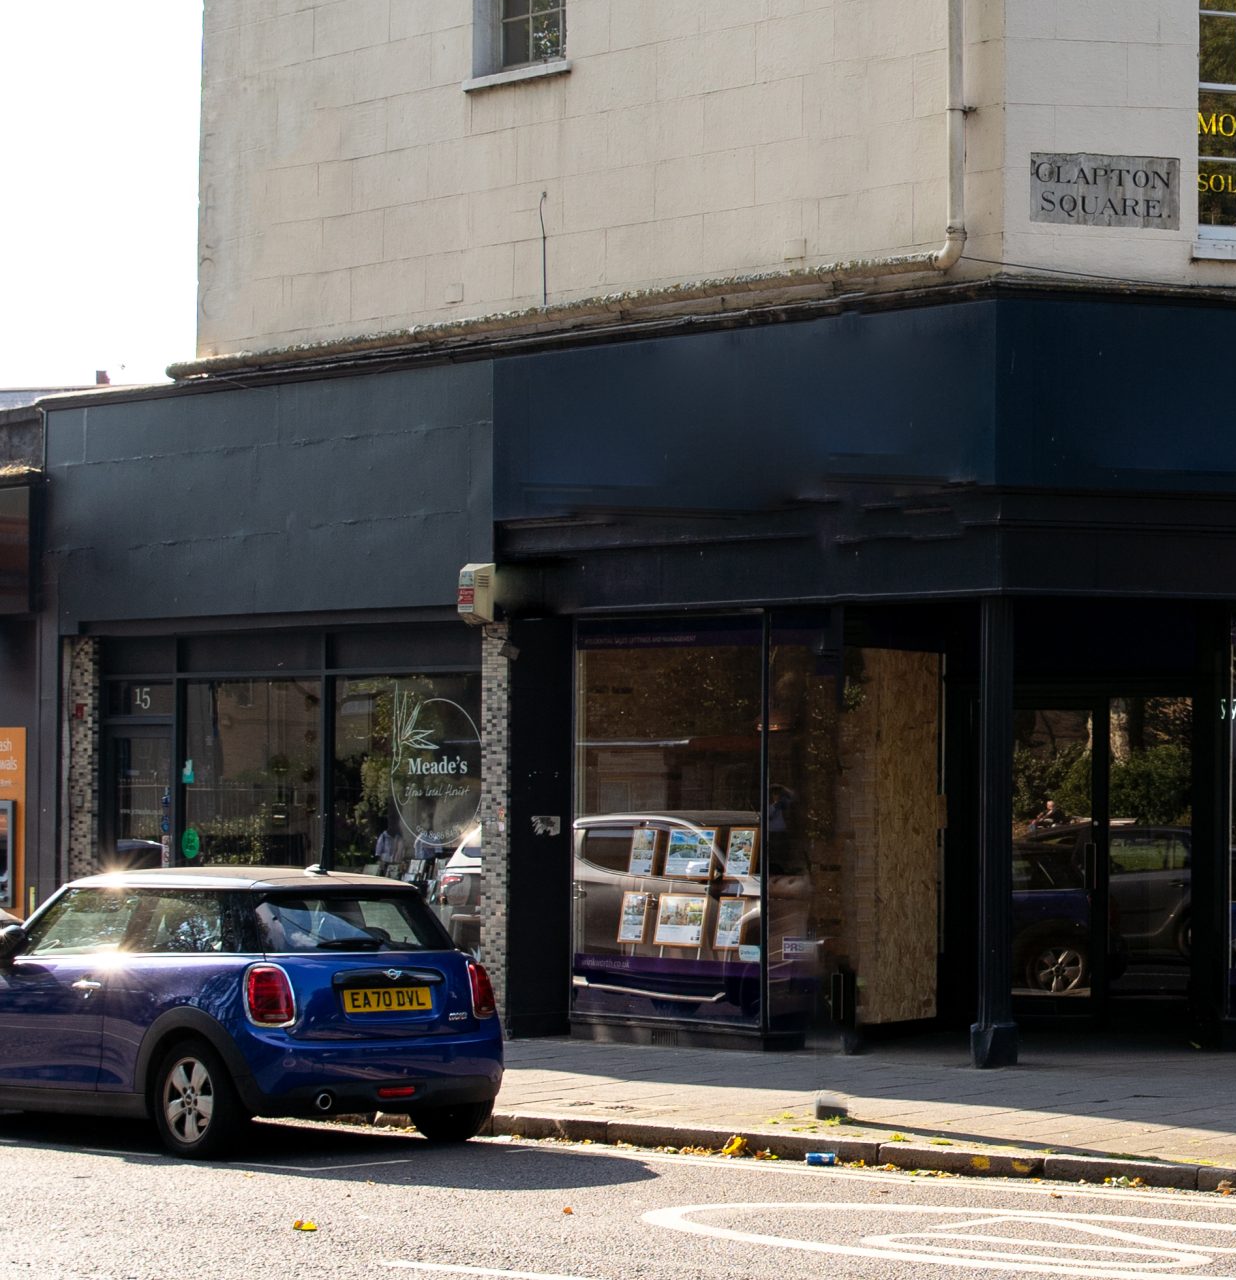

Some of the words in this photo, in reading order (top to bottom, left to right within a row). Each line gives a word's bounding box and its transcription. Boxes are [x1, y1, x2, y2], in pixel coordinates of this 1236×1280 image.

[1035, 161, 1171, 190] CLAPTON
[135, 687, 151, 709] 15
[407, 756, 468, 775] Meade's
[350, 990, 393, 1009] EA70
[397, 990, 426, 1007] DVL
